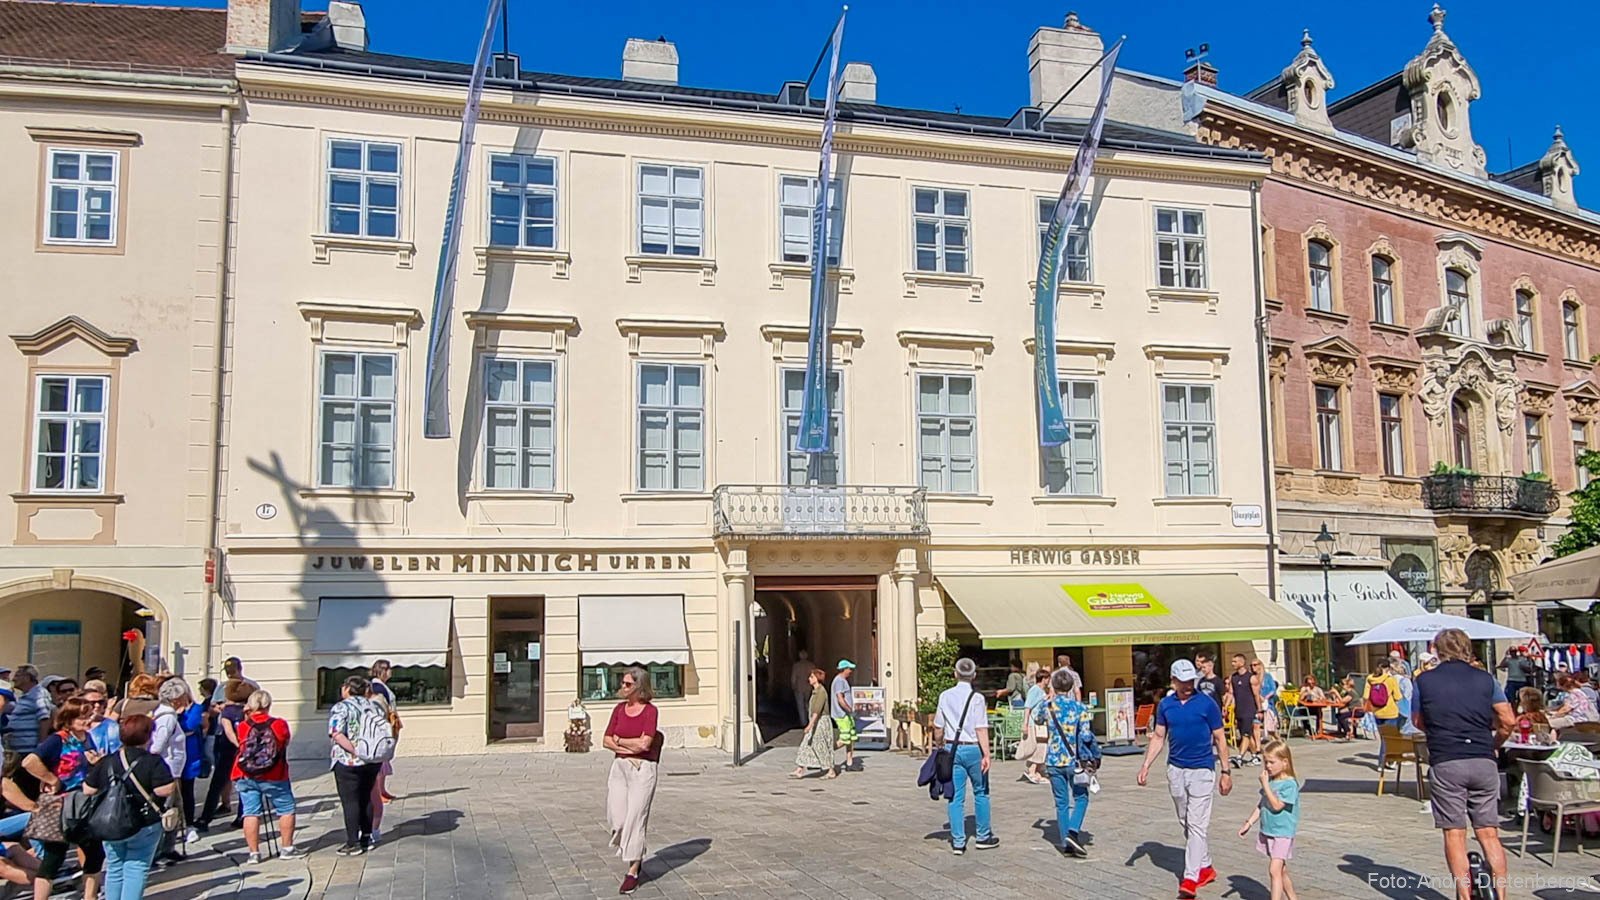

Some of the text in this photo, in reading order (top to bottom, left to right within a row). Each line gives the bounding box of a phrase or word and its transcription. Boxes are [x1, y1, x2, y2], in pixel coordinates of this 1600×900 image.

[312, 553, 691, 573] JUWELEN MINNICH UHREN
[1010, 549, 1140, 565] HERWIG GASSER
[1087, 595, 1137, 606] Gasser
